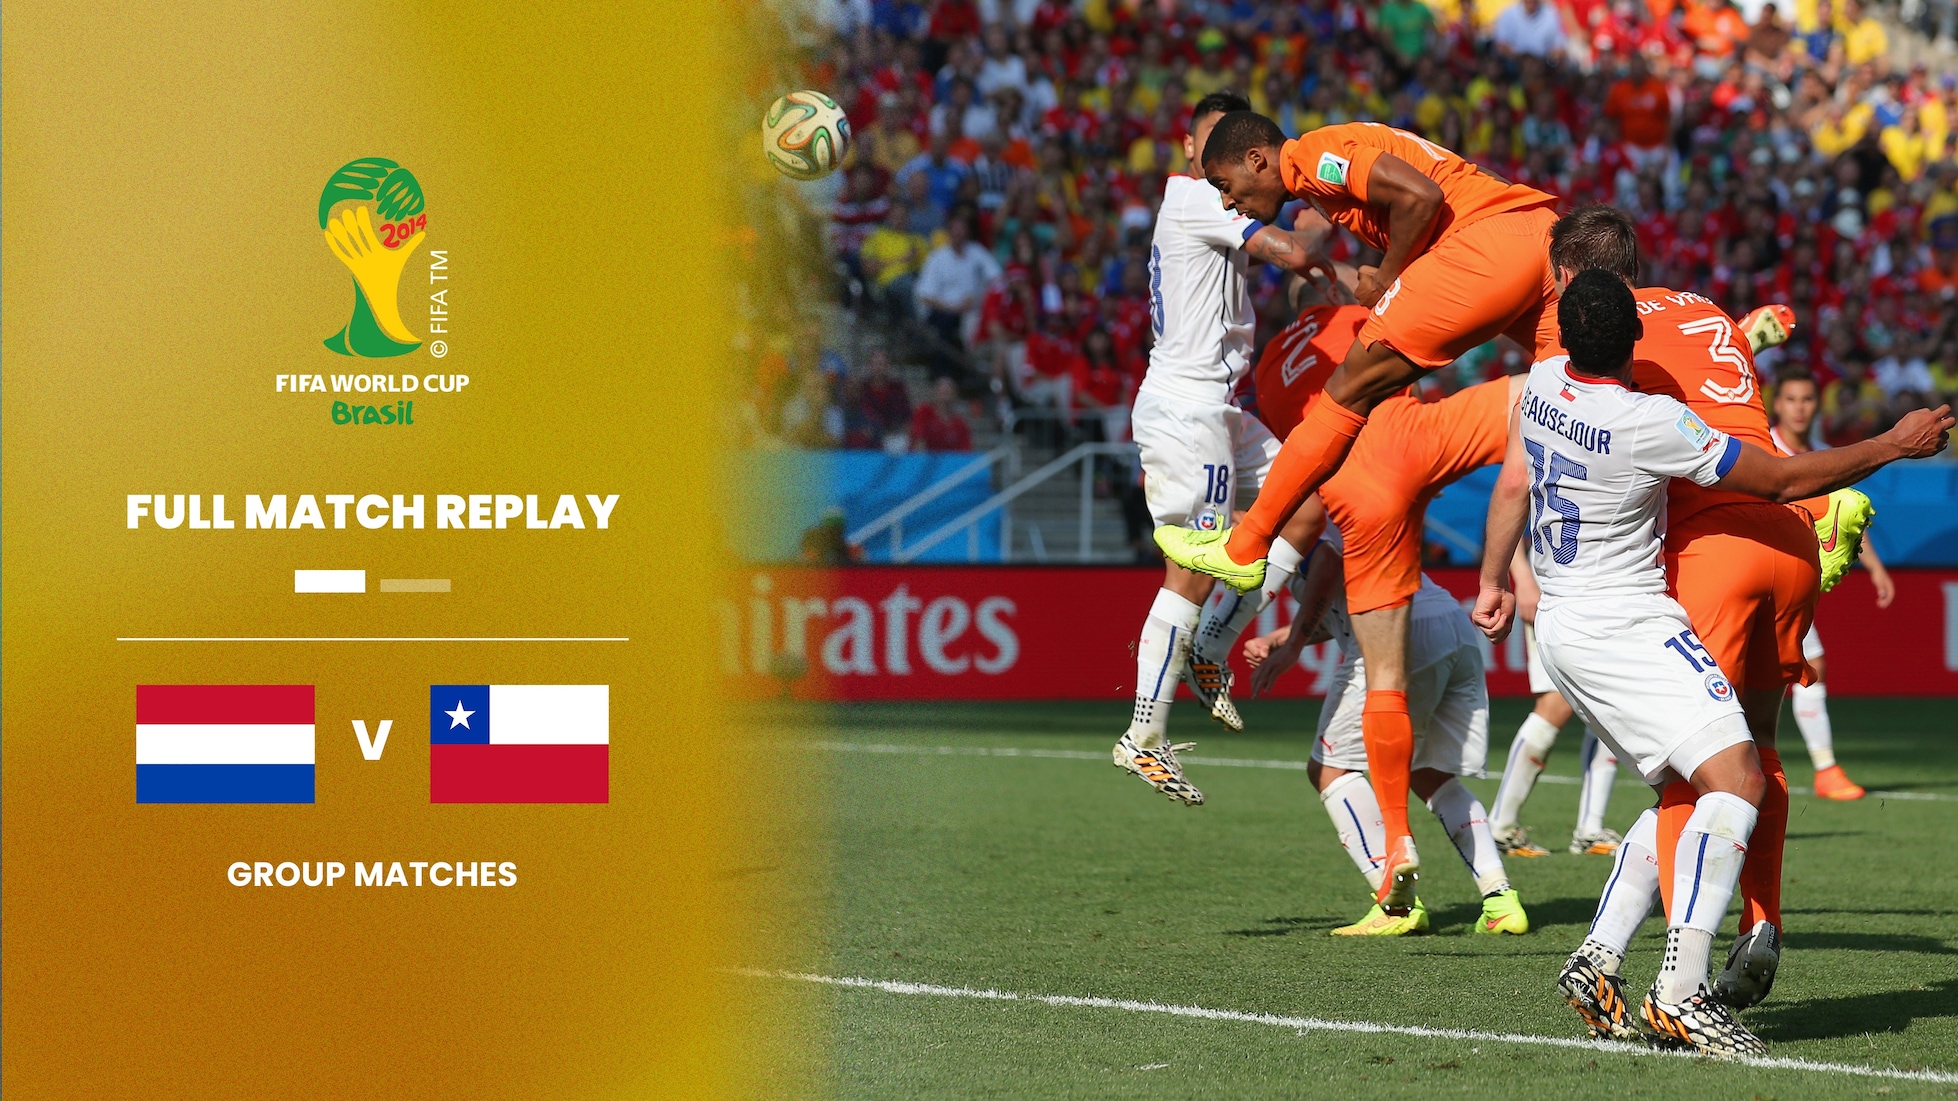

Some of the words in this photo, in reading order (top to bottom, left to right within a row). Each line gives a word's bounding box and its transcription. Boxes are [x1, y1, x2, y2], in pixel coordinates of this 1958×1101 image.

[1635, 299, 1667, 315] DE
[1281, 321, 1317, 387] 2
[1677, 316, 1754, 404] 3
[1203, 464, 1229, 504] 18
[1524, 436, 1588, 565] 15
[1664, 629, 1717, 673] 15
